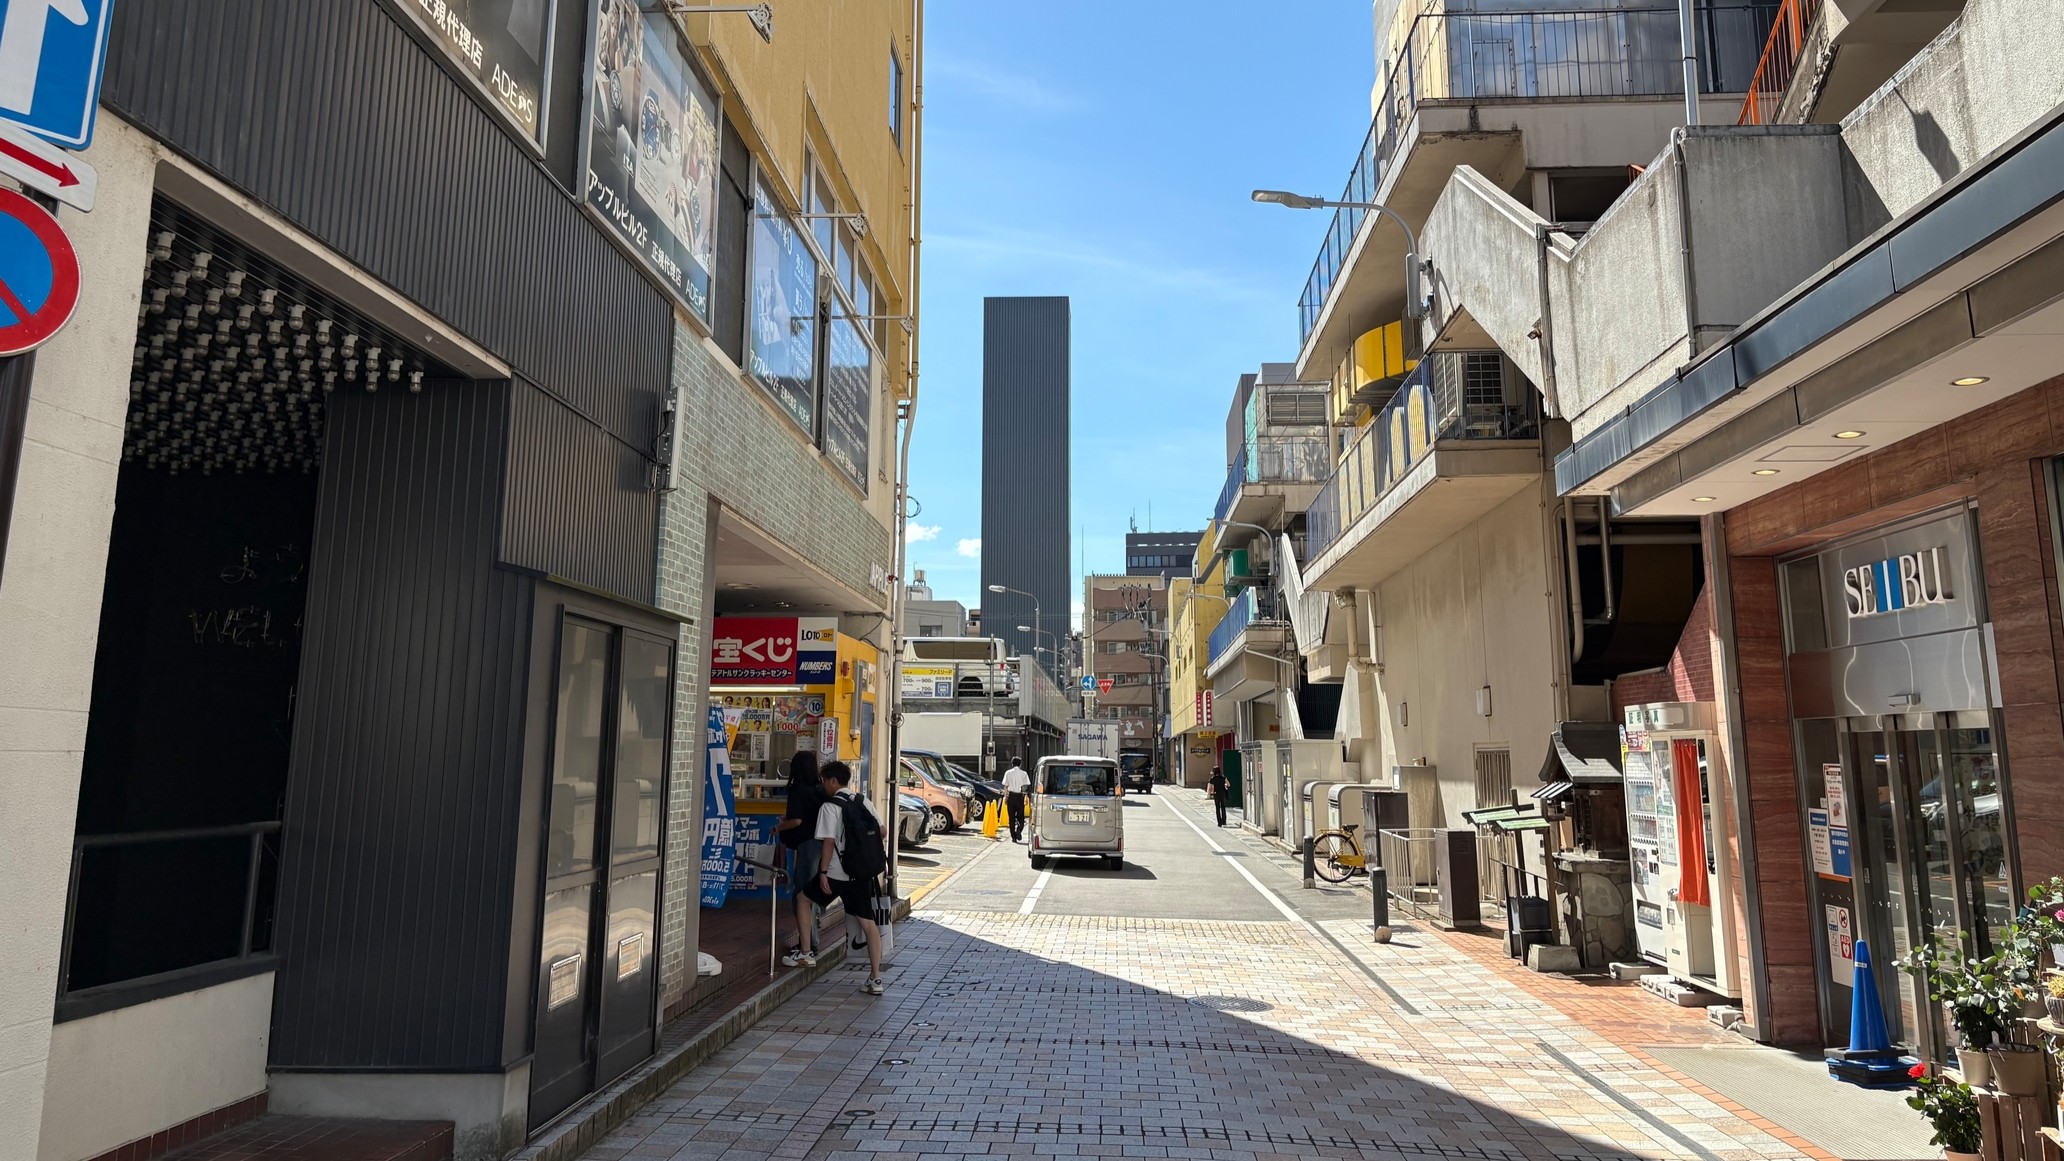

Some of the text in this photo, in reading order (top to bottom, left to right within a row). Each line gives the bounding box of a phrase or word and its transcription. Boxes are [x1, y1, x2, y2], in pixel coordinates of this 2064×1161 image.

[1844, 547, 1946, 618] SEIBU
[713, 637, 793, 663] 宝くじ
[799, 661, 833, 671] NUMBERS
